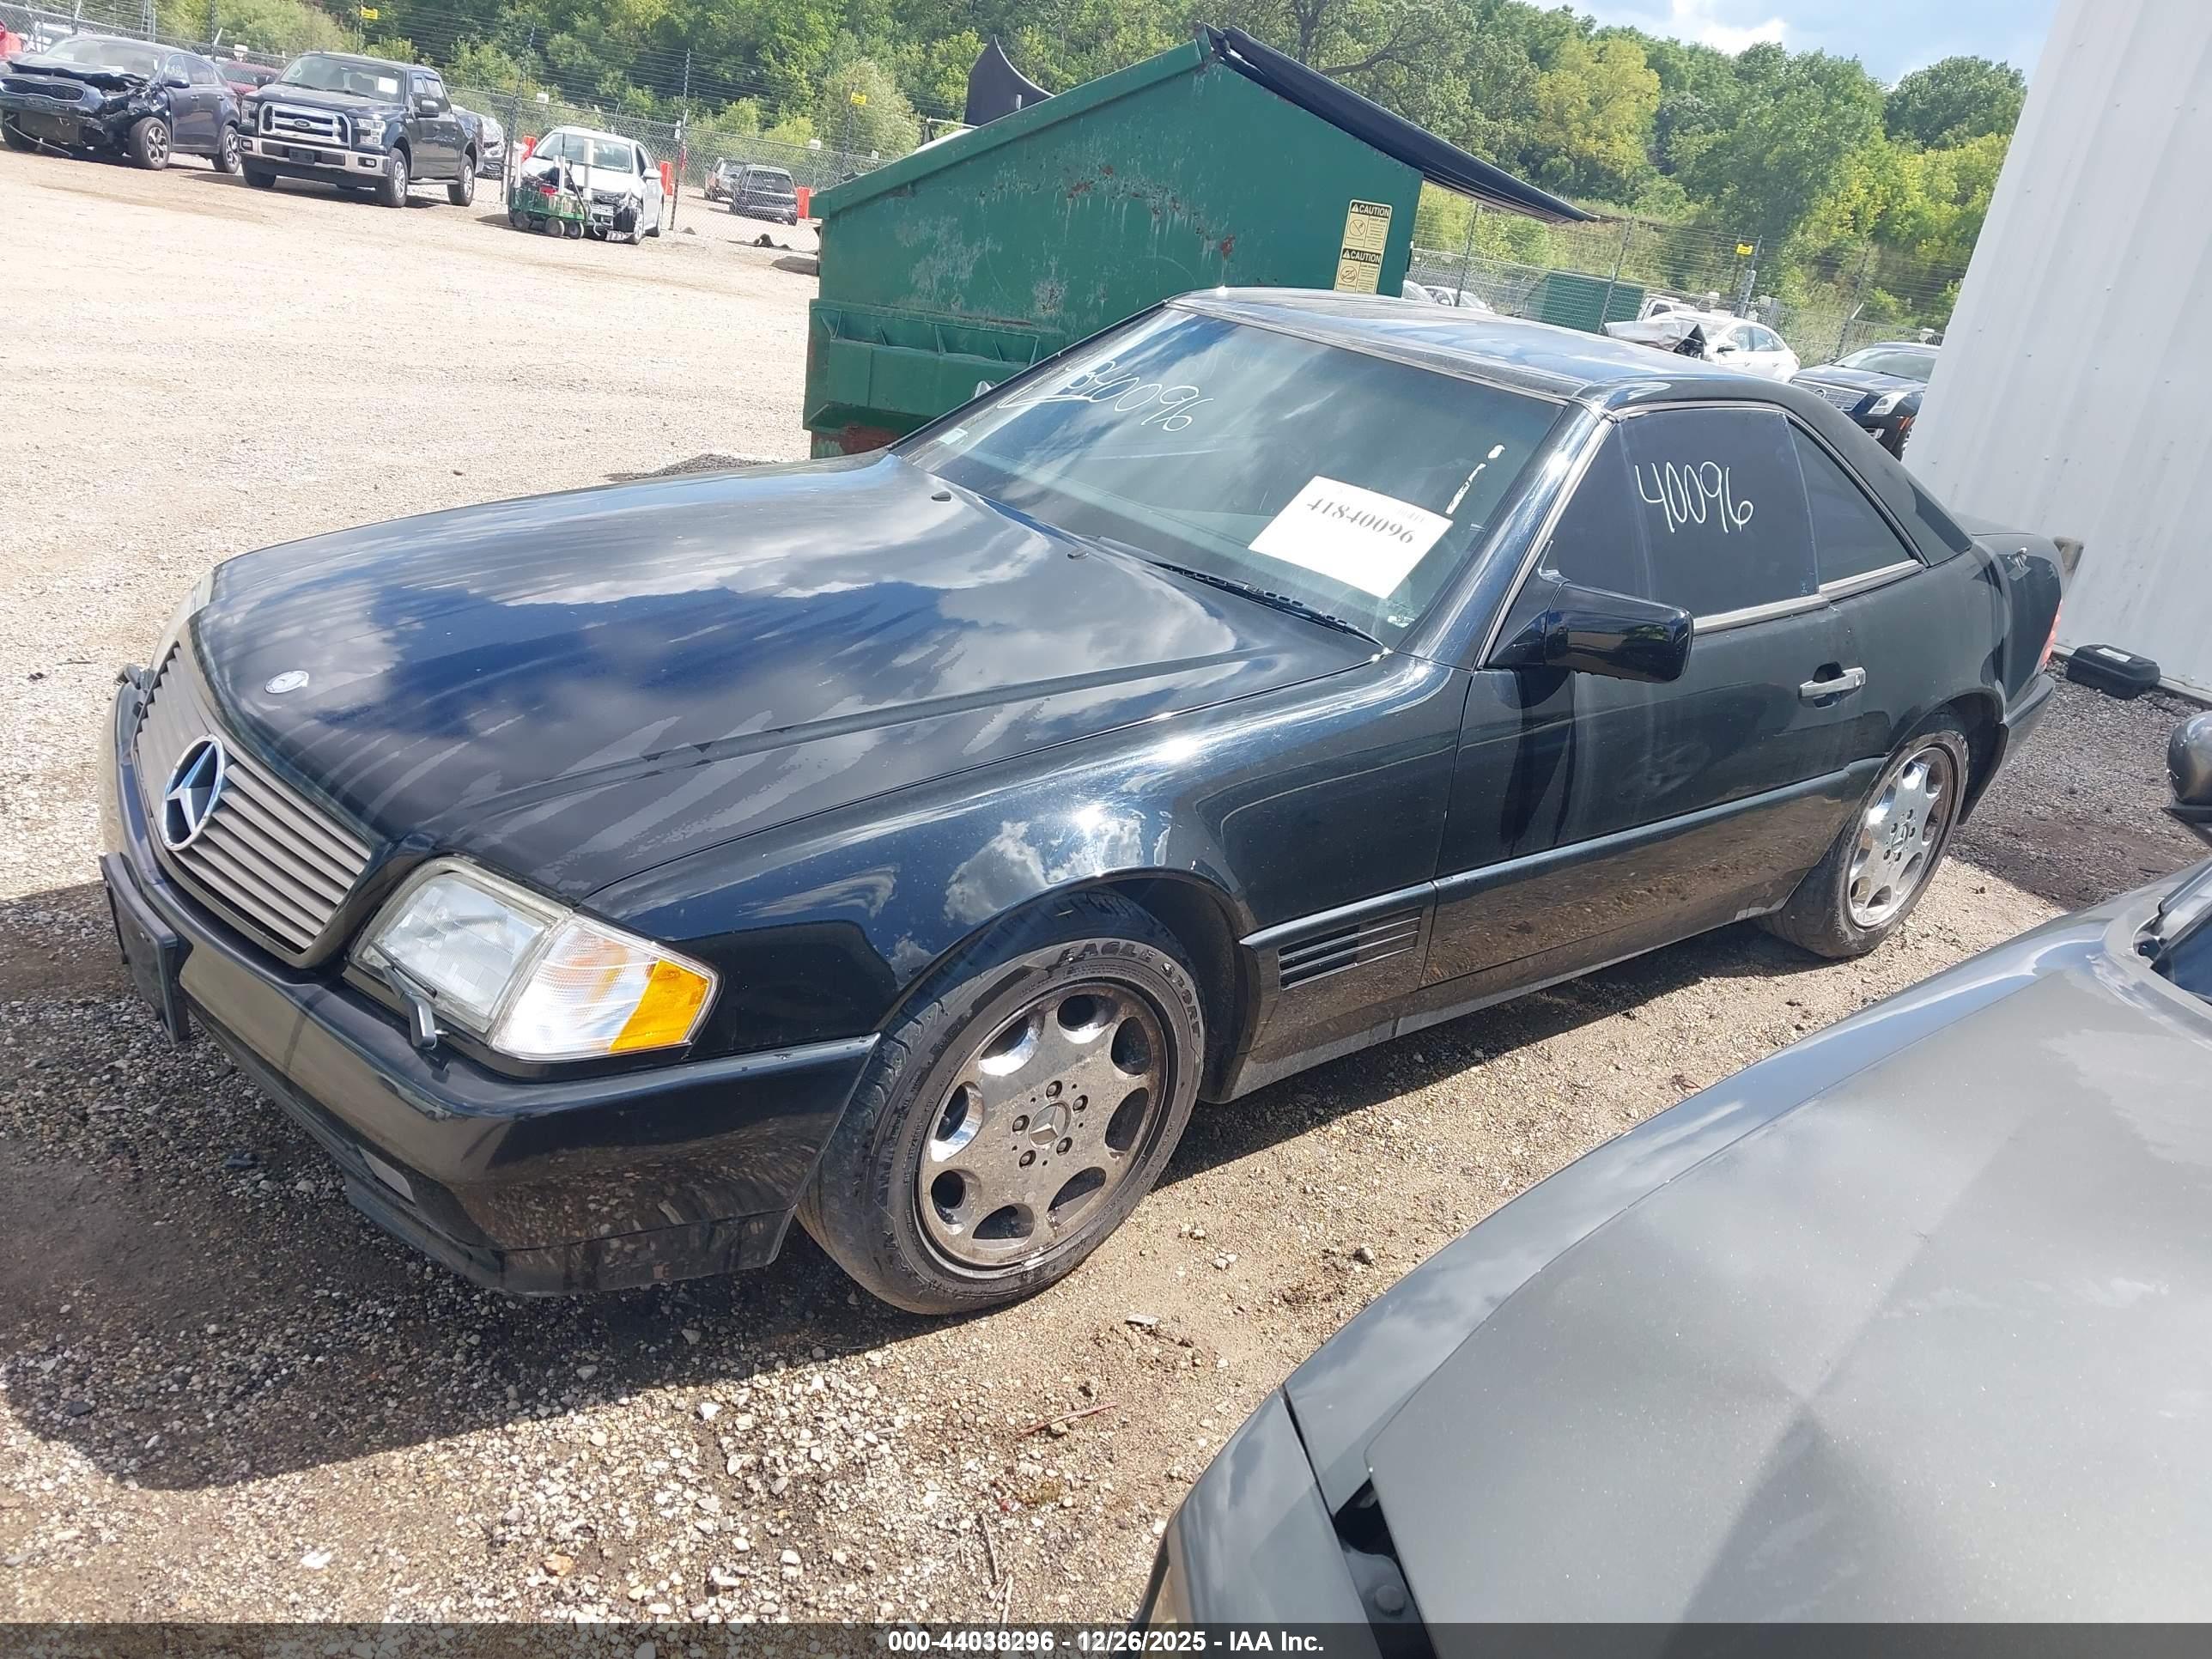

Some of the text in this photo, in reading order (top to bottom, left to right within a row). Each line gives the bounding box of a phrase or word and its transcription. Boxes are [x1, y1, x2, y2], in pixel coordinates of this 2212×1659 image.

[1359, 205, 1390, 216] CAUTION
[1351, 250, 1381, 262] CAUTION
[1634, 460, 1754, 533] 40096
[1306, 497, 1414, 544] 41840096
[1057, 941, 1158, 964] EAGLE
[1159, 961, 1201, 1039] SPORT
